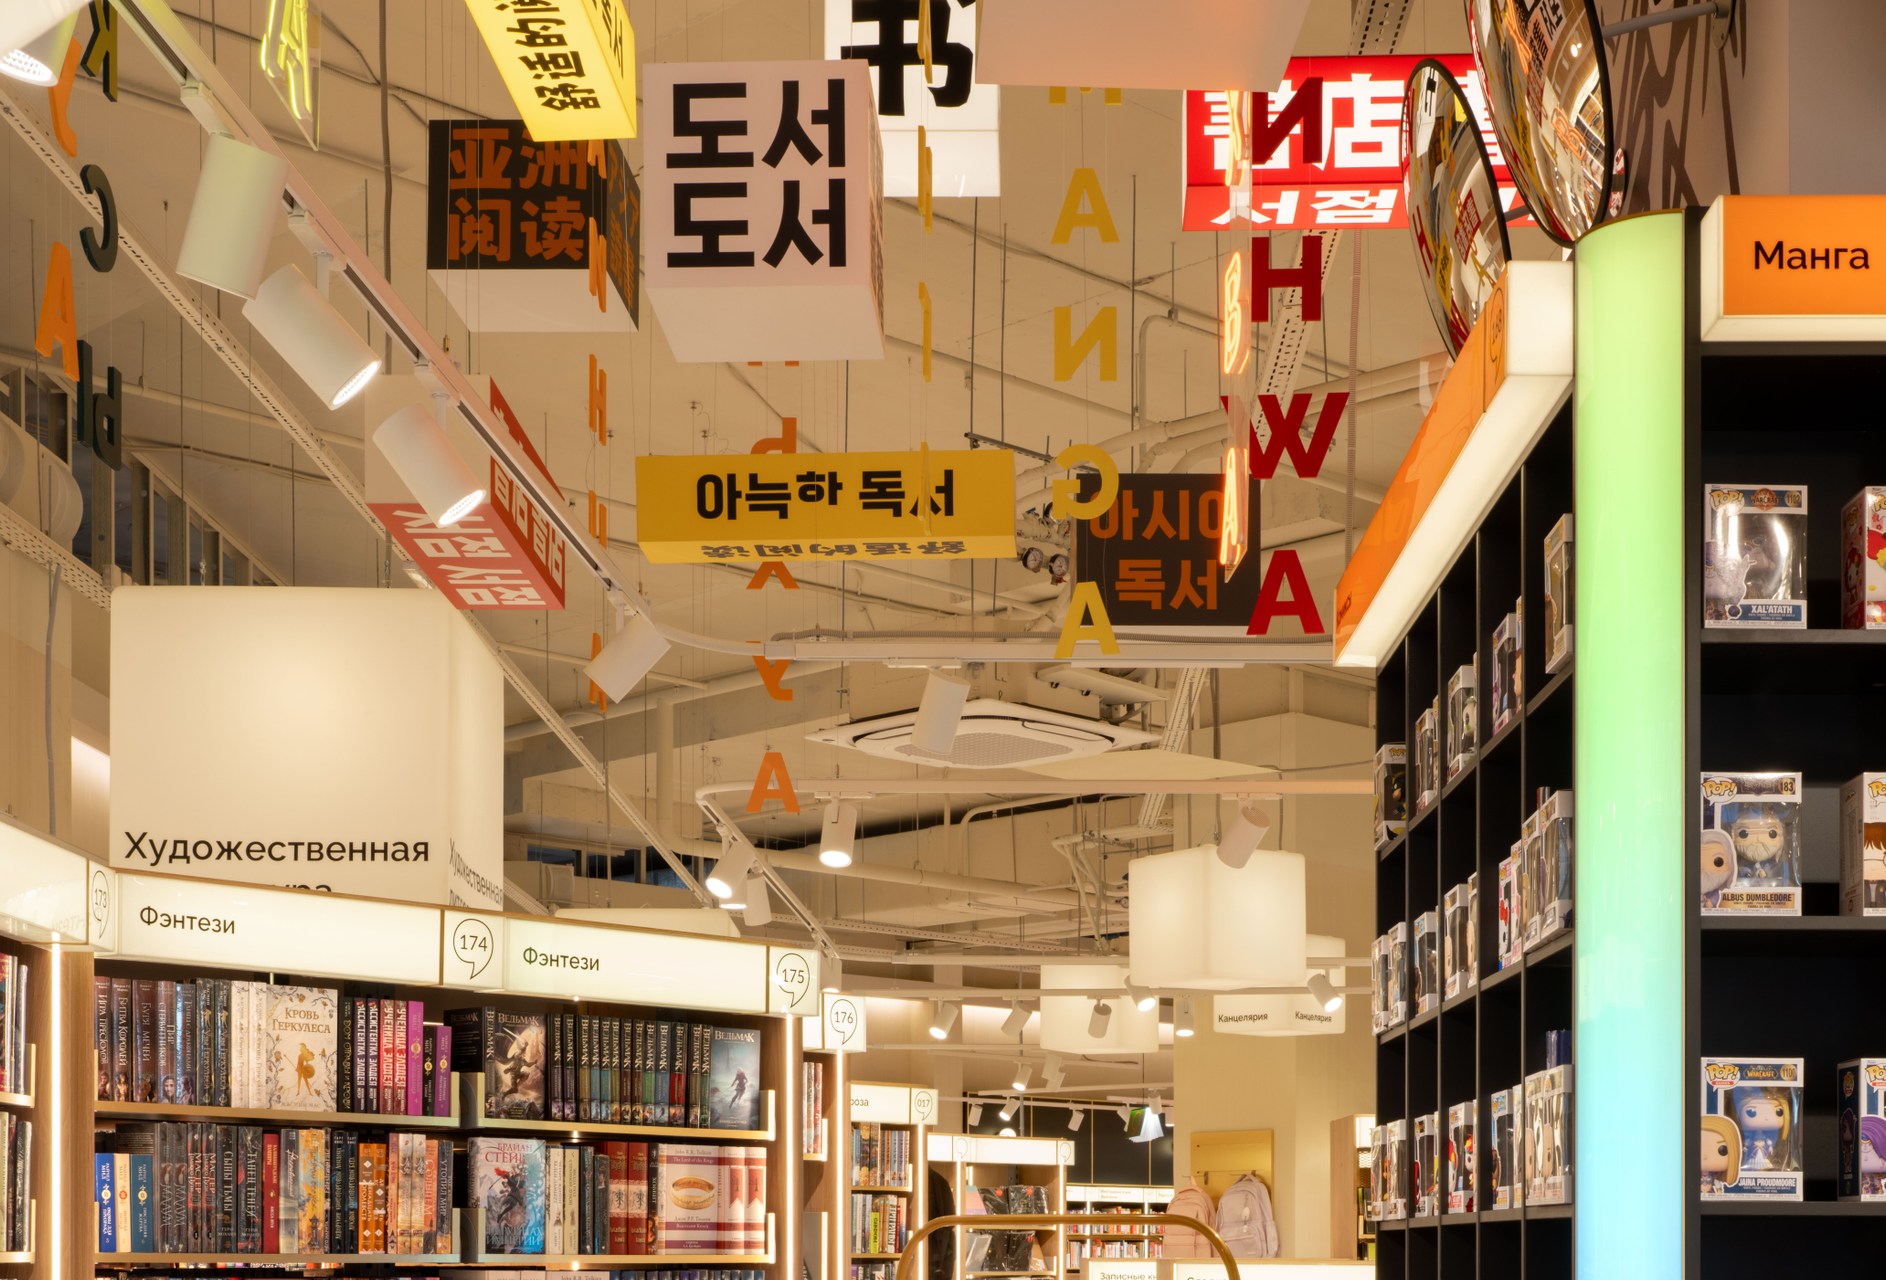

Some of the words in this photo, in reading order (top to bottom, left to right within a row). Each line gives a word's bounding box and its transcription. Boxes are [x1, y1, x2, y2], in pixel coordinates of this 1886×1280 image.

[665, 78, 847, 169] 도서
[447, 128, 588, 190] 亚洲
[447, 196, 586, 262] 阅读
[666, 178, 848, 269] 도서
[1753, 240, 1870, 269] Манга
[1710, 490, 1744, 507] POP!
[1114, 560, 1220, 610] 독서
[1751, 605, 1793, 614] XAL'ATATH
[1702, 780, 1737, 798] POP!
[124, 831, 430, 867] Художественная
[1722, 893, 1744, 902] ALBUS
[1746, 893, 1792, 902] DUMBLEDORE
[138, 906, 236, 936] Фэнтези
[459, 934, 489, 954] 174
[522, 946, 601, 972] Фэнтези
[781, 966, 805, 987] 175
[285, 1007, 320, 1020] КРОВЬ
[497, 1012, 540, 1027] ВЕДЬМАК
[833, 1010, 855, 1027] 176
[1217, 1011, 1269, 1025] Канцелярия
[1294, 1010, 1333, 1024] Канцелярия
[271, 1019, 331, 1034] ГЕРКУЛЕСА
[714, 1030, 755, 1043] ВЕДЬМАК
[1705, 1063, 1740, 1081] POP!
[916, 1099, 931, 1108] 017
[223, 1151, 233, 1181] СЫНЫ
[1738, 1178, 1756, 1187] JAINA
[1757, 1178, 1796, 1187] PROUDMOORE
